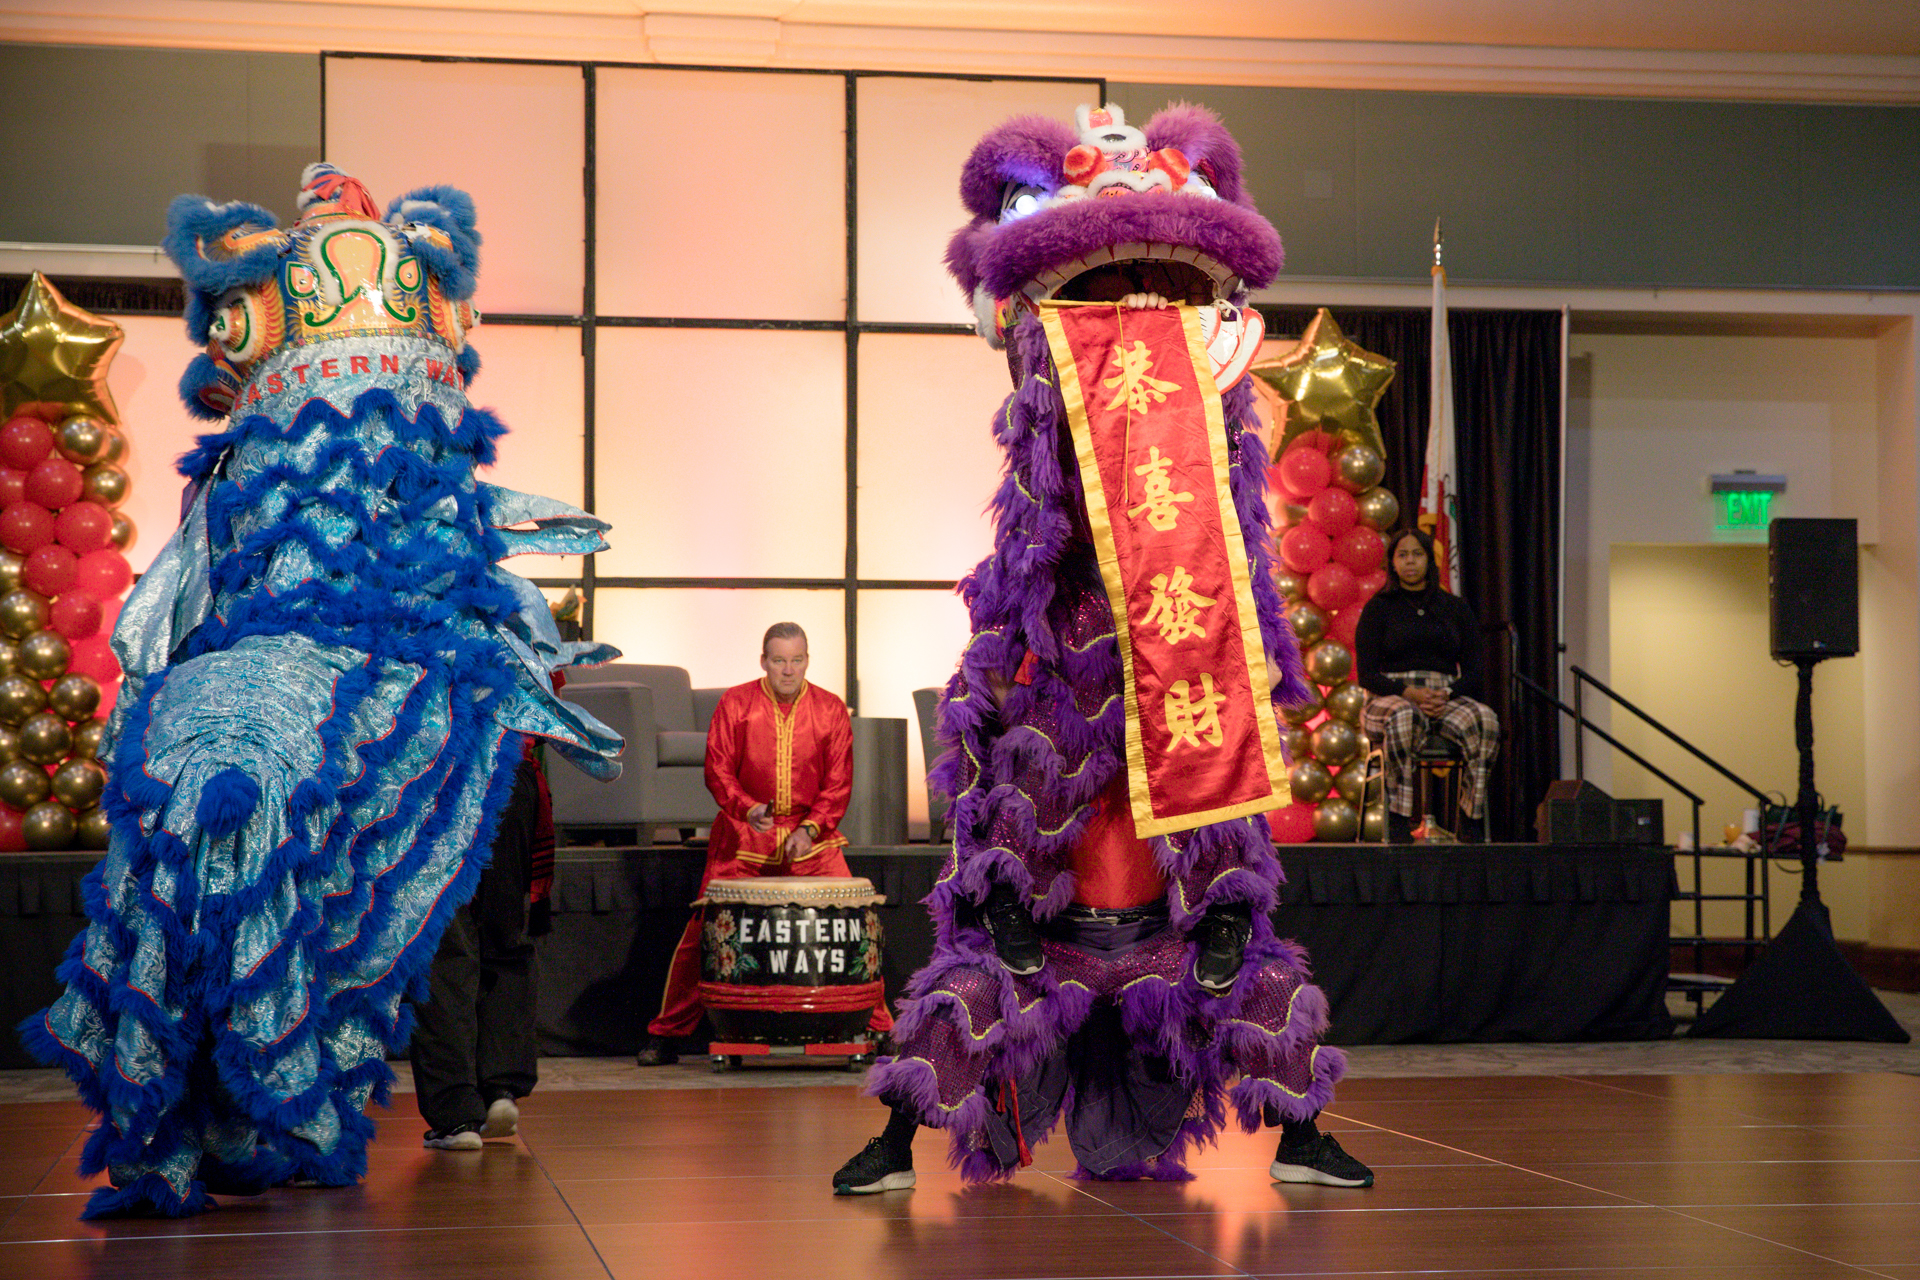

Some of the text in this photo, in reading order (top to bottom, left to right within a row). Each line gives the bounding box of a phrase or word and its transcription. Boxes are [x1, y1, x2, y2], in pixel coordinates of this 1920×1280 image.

[1727, 493, 1772, 525] EXIT
[1103, 341, 1226, 753] 恭喜發財
[739, 918, 861, 944] EASTERN
[769, 949, 846, 974] WAYS
